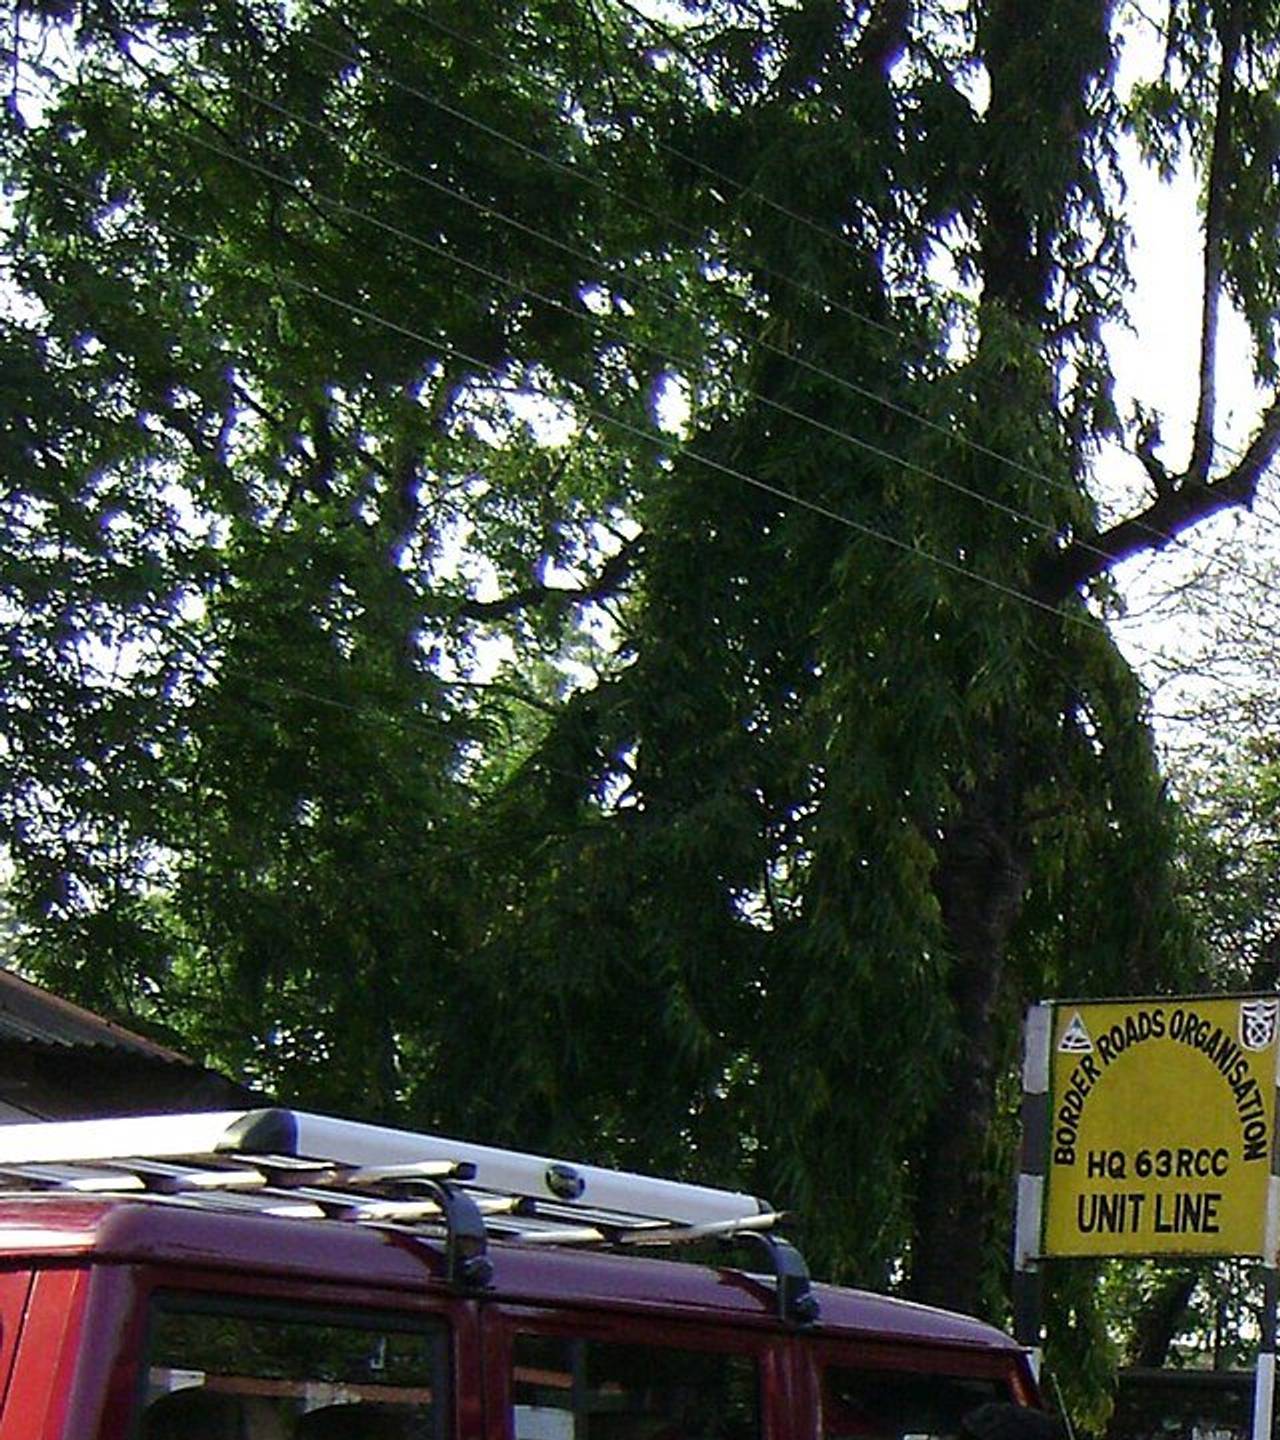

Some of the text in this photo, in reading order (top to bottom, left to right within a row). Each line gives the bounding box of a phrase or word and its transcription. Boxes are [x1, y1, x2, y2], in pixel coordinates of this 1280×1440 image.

[1054, 1009, 1268, 1166] BORDER ROADS ORGANISATION
[1088, 1151, 1127, 1179] HQ
[1077, 1194, 1222, 1234] UNIT LINE
